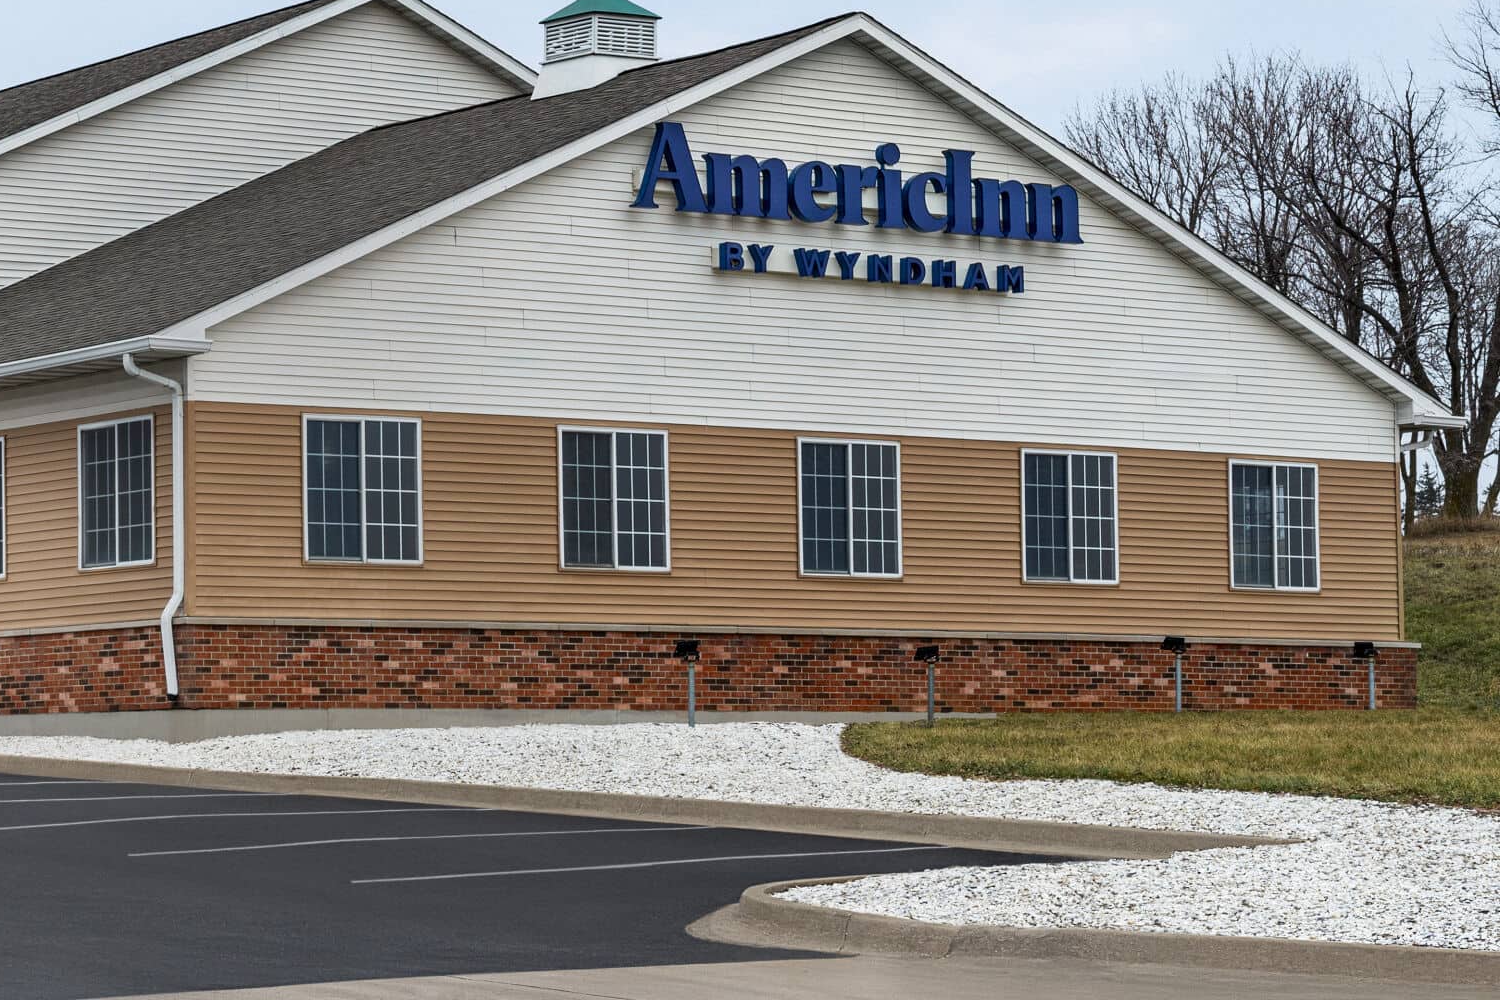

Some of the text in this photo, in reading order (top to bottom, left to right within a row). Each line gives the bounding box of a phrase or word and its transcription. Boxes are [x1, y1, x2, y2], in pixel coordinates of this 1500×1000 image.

[629, 121, 1085, 244] AmericInn
[718, 241, 1025, 293] BY WYNDHAM
